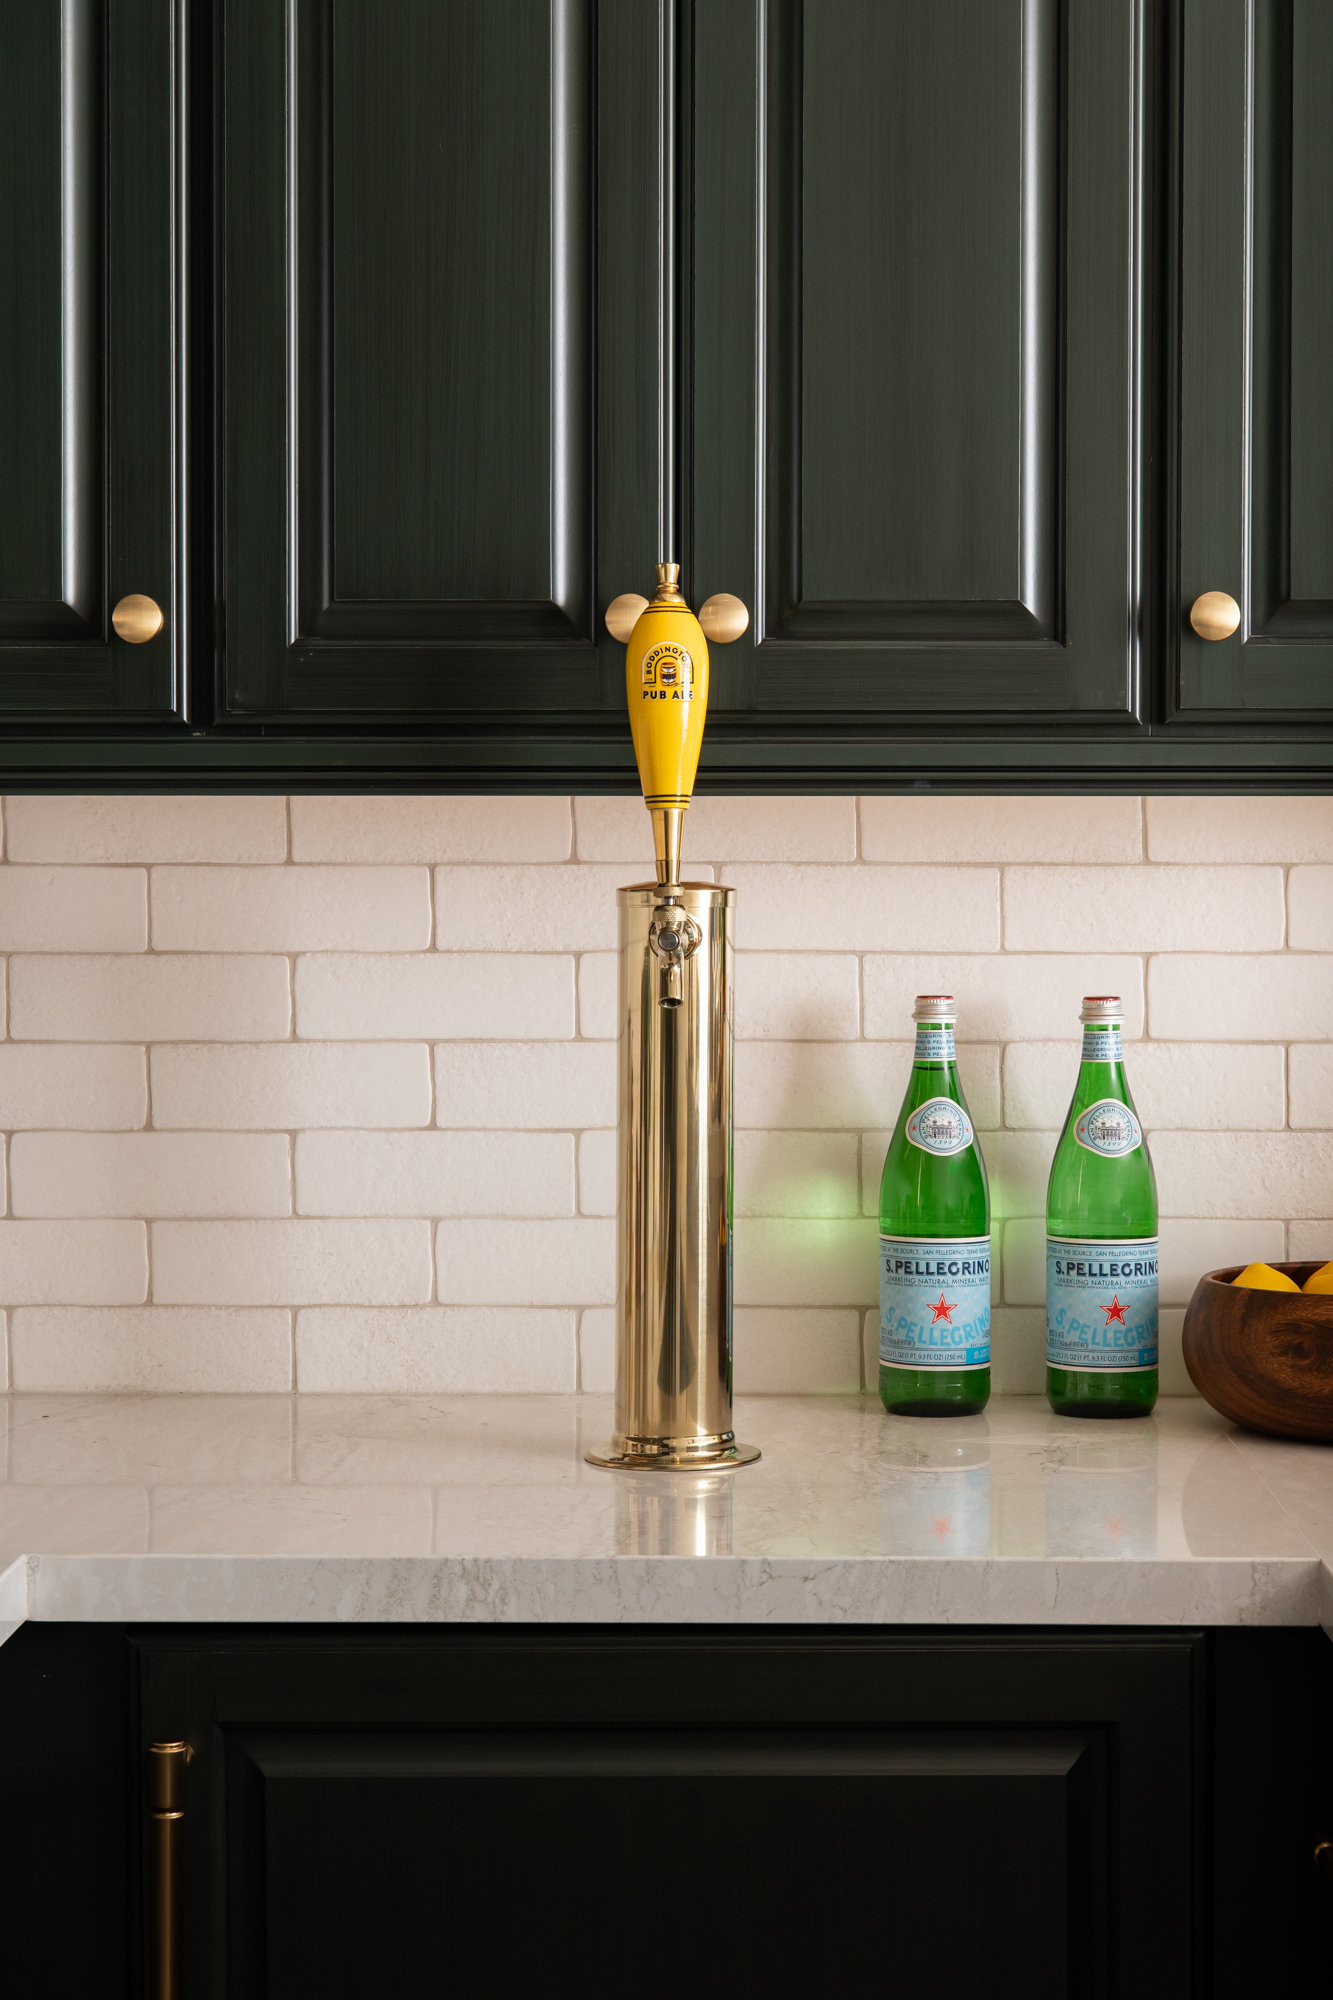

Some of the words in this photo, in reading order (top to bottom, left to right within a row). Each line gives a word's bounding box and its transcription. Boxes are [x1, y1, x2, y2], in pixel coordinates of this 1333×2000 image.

[645, 646, 691, 675] BODDINGTO
[643, 690, 667, 700] PUB
[922, 1106, 957, 1124] PELLEGRINO
[1090, 1108, 1126, 1126] PELLEGRINO
[885, 1259, 990, 1276] S.PELLEGRINO
[887, 1275, 916, 1284] SPARKLING
[1057, 1277, 1089, 1286] SPARKLING
[886, 1306, 990, 1346] S.PELLEGRINO
